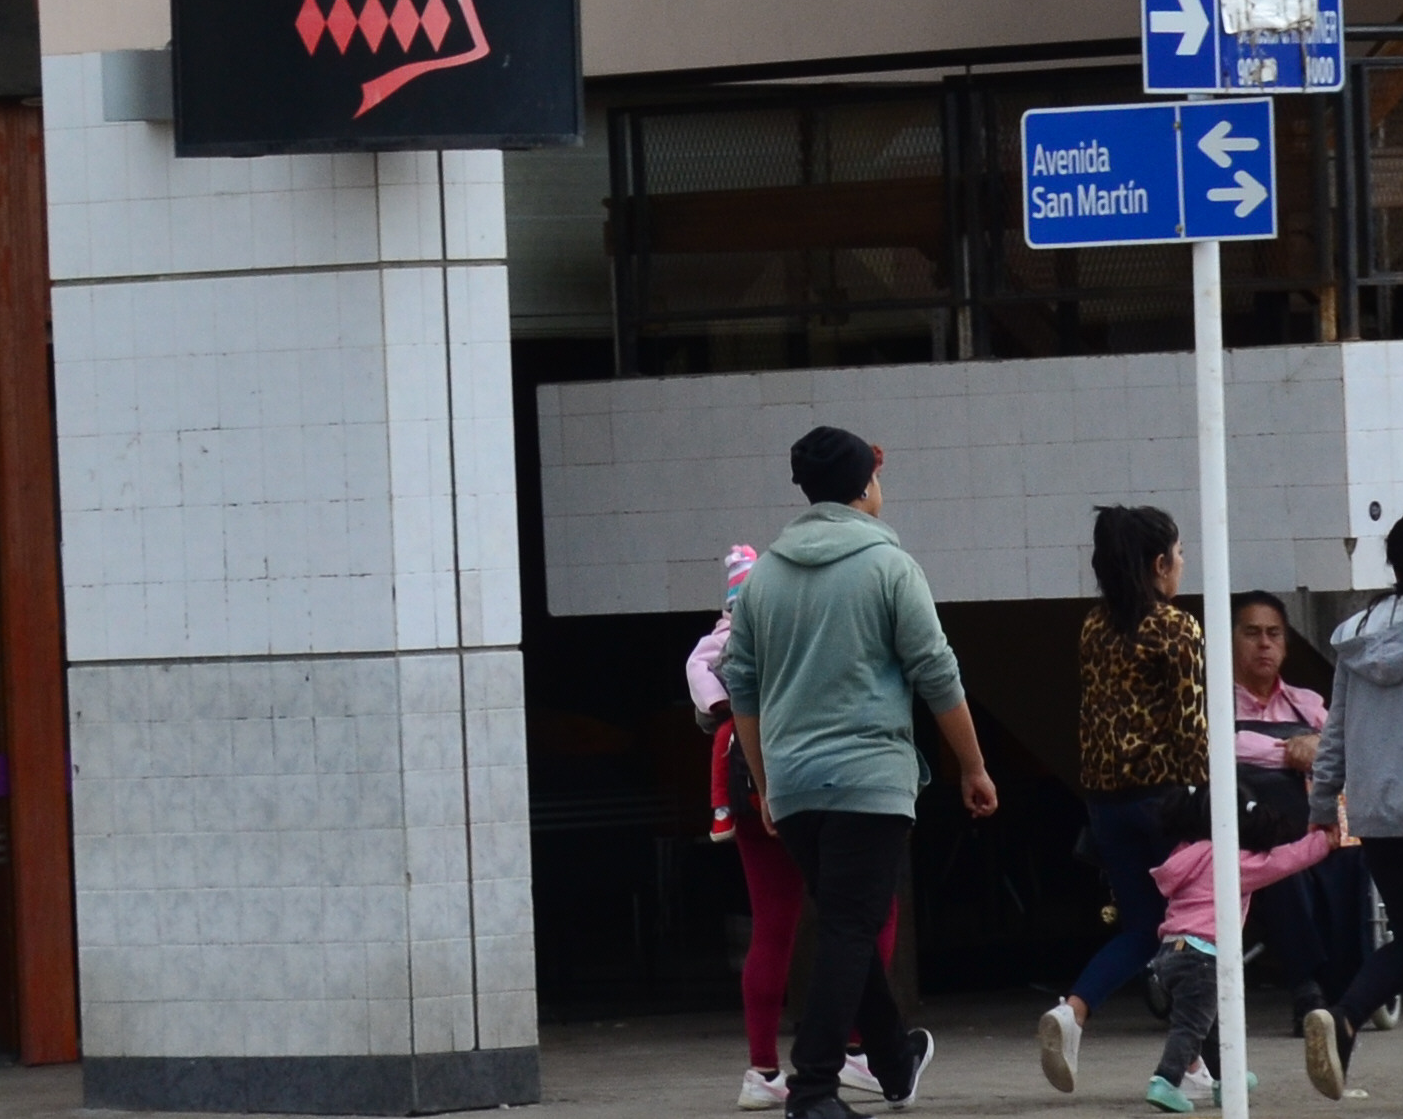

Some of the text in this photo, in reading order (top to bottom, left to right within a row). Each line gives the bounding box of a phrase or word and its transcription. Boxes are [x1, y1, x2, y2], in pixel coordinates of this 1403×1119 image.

[1031, 139, 1111, 177] Avenida
[1031, 180, 1149, 219] San Martín
